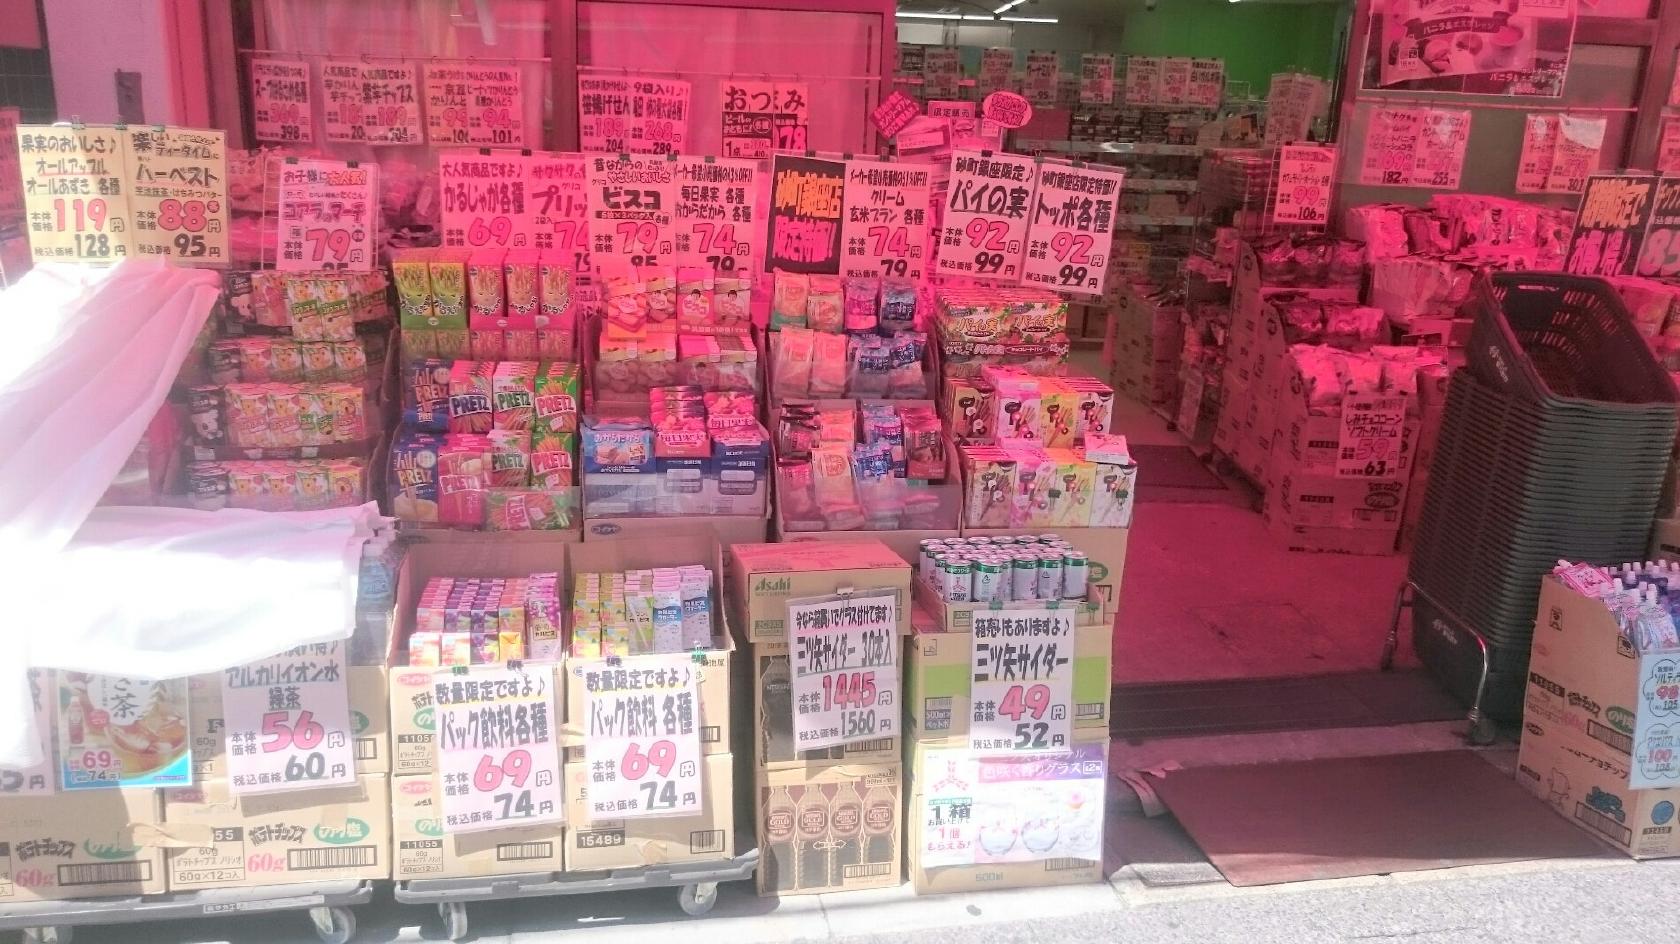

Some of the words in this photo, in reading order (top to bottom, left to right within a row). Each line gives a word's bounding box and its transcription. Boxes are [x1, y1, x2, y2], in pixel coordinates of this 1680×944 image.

[21, 134, 110, 153] 果実のおいしさ
[493, 130, 512, 143] 101
[653, 142, 672, 155] 289
[136, 163, 220, 187] ハーベスト
[442, 162, 516, 178] 大人気商品ですよ
[956, 157, 1025, 182] 砂町銀座限定
[1382, 171, 1402, 184] 182
[26, 177, 91, 195] オールあずき
[98, 178, 120, 196] 各種
[444, 182, 524, 214] かるじゃが各種
[603, 186, 661, 210] ビスコ
[681, 186, 719, 202] 毎日果実
[726, 187, 745, 204] 各種
[871, 189, 904, 206] クリーム
[950, 179, 1029, 219] パイの実
[54, 198, 107, 232] 119
[158, 199, 207, 232] 88
[284, 202, 365, 223] コアラのマーチ
[655, 215, 669, 225] 各種
[732, 206, 751, 222] 各種
[904, 209, 924, 225] 各種
[1034, 192, 1112, 233] トッポ各種
[1299, 207, 1317, 220] 106
[468, 216, 512, 246] 69
[616, 222, 658, 254] 79
[693, 223, 736, 255] 74
[868, 226, 910, 257] 74
[966, 218, 1010, 251] 92
[74, 233, 110, 257] 128
[174, 233, 207, 257] 95
[306, 228, 350, 261] 79
[1051, 231, 1094, 264] 92
[881, 259, 907, 277] 79
[975, 251, 1004, 273] 99
[1059, 264, 1088, 286] 99
[452, 397, 490, 415] PRETZ
[498, 392, 532, 407] PRETZ
[537, 397, 573, 413] PRETZ
[1346, 414, 1402, 424] しみチョココーン
[492, 453, 524, 469] PRETZ
[533, 454, 570, 472] PRETZ
[1365, 461, 1386, 475] 63
[755, 577, 791, 591] Asahi
[797, 633, 856, 676] 三ツ矢サイダー
[862, 629, 892, 666] 30本入
[974, 643, 1069, 682] 三ツ矢サイダー
[225, 659, 339, 687] アルカリイオン水
[586, 667, 680, 693] 数量限定ですよ
[268, 686, 301, 711] 緑茶
[435, 676, 533, 705] 数量限定ですよ
[823, 671, 876, 712] 1445
[999, 684, 1050, 721] 49
[441, 702, 549, 749] パック飲料各種
[591, 694, 657, 737] パック飲料
[663, 692, 693, 735] 各種
[840, 709, 876, 736] 1560
[262, 710, 325, 753] 56
[1014, 722, 1049, 748] 52
[83, 751, 111, 768] 69
[285, 752, 326, 782] 60
[474, 750, 532, 792] 69
[621, 740, 677, 780] 69
[88, 770, 105, 780] 74
[494, 790, 534, 818] 74
[640, 781, 677, 810] 74
[932, 804, 971, 821] 1箱
[249, 823, 308, 847] ポテトチップス
[581, 835, 620, 846] 15489
[248, 853, 287, 872] 60g
